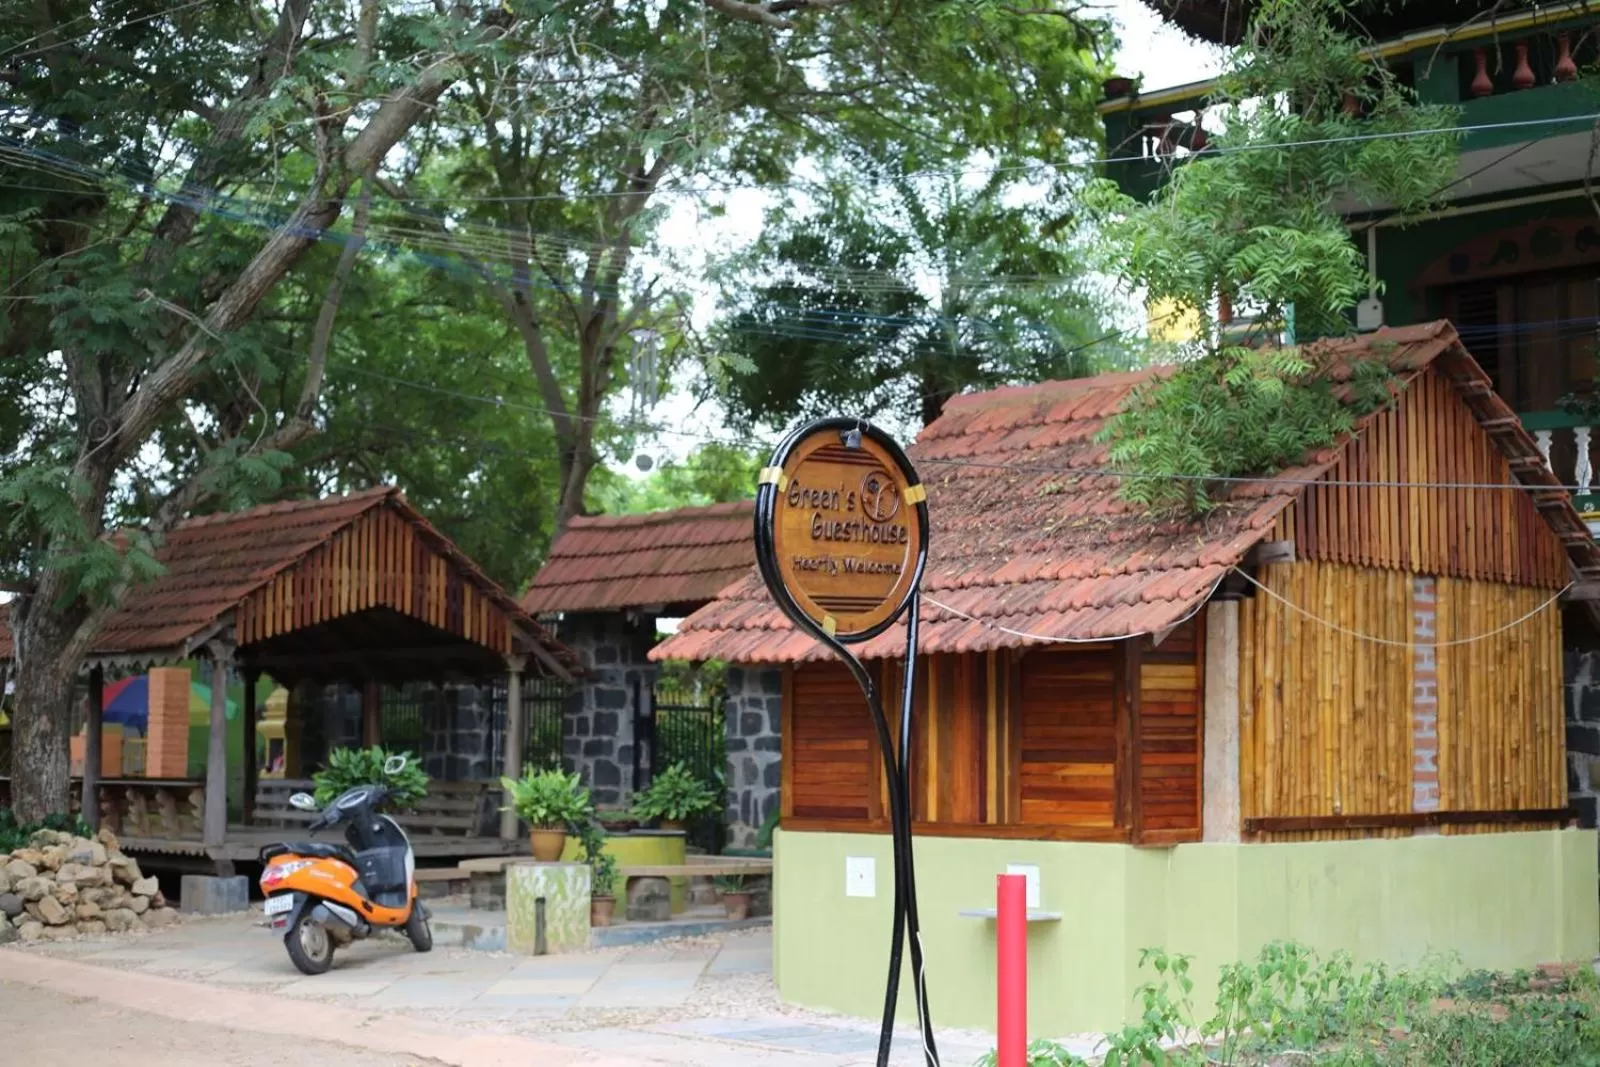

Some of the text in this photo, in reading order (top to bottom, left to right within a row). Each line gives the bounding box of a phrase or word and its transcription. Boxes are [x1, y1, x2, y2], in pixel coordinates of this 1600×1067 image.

[788, 479, 855, 511] Green's
[811, 512, 908, 544] Guesthouse
[842, 556, 902, 575] Welcome
